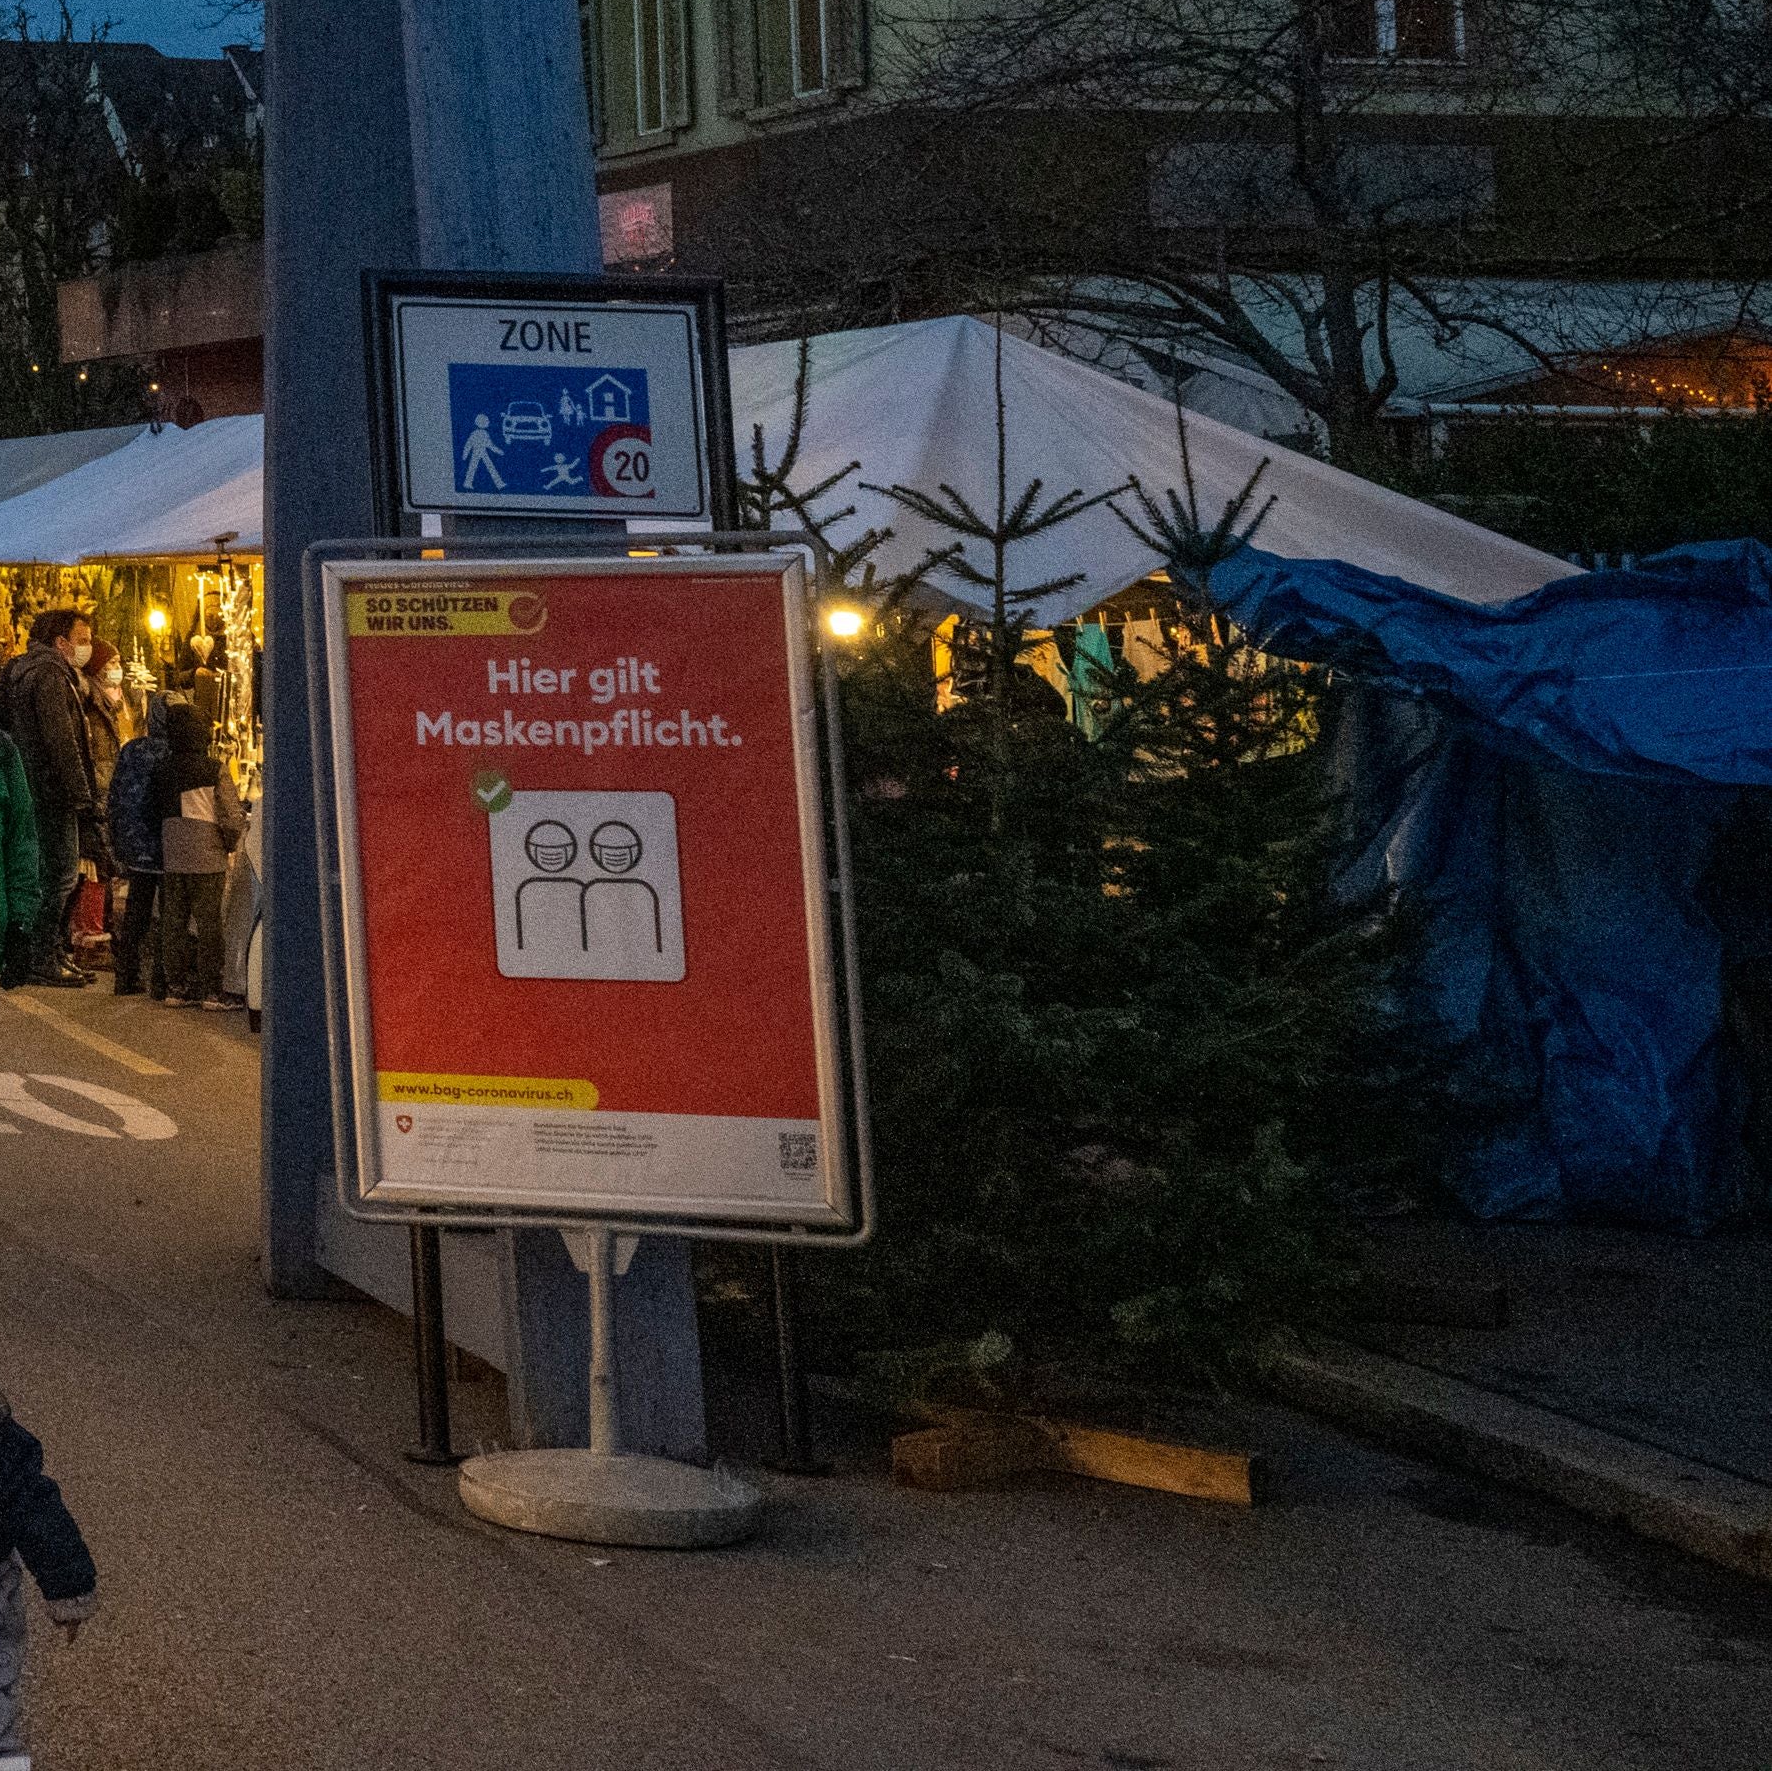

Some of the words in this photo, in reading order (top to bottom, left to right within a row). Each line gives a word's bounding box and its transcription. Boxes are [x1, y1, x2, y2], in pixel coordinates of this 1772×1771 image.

[498, 318, 594, 354] ZONE
[613, 449, 651, 484] 20
[365, 596, 393, 614] SO
[395, 594, 500, 614] SCHÜTZEN
[365, 615, 406, 631] WIR
[407, 615, 454, 632] UNS.
[486, 659, 580, 698] Hier
[588, 657, 663, 703] gilt
[414, 708, 745, 756] Maskenpflicht.
[392, 1080, 575, 1104] www.bag-coronavirus.ch
